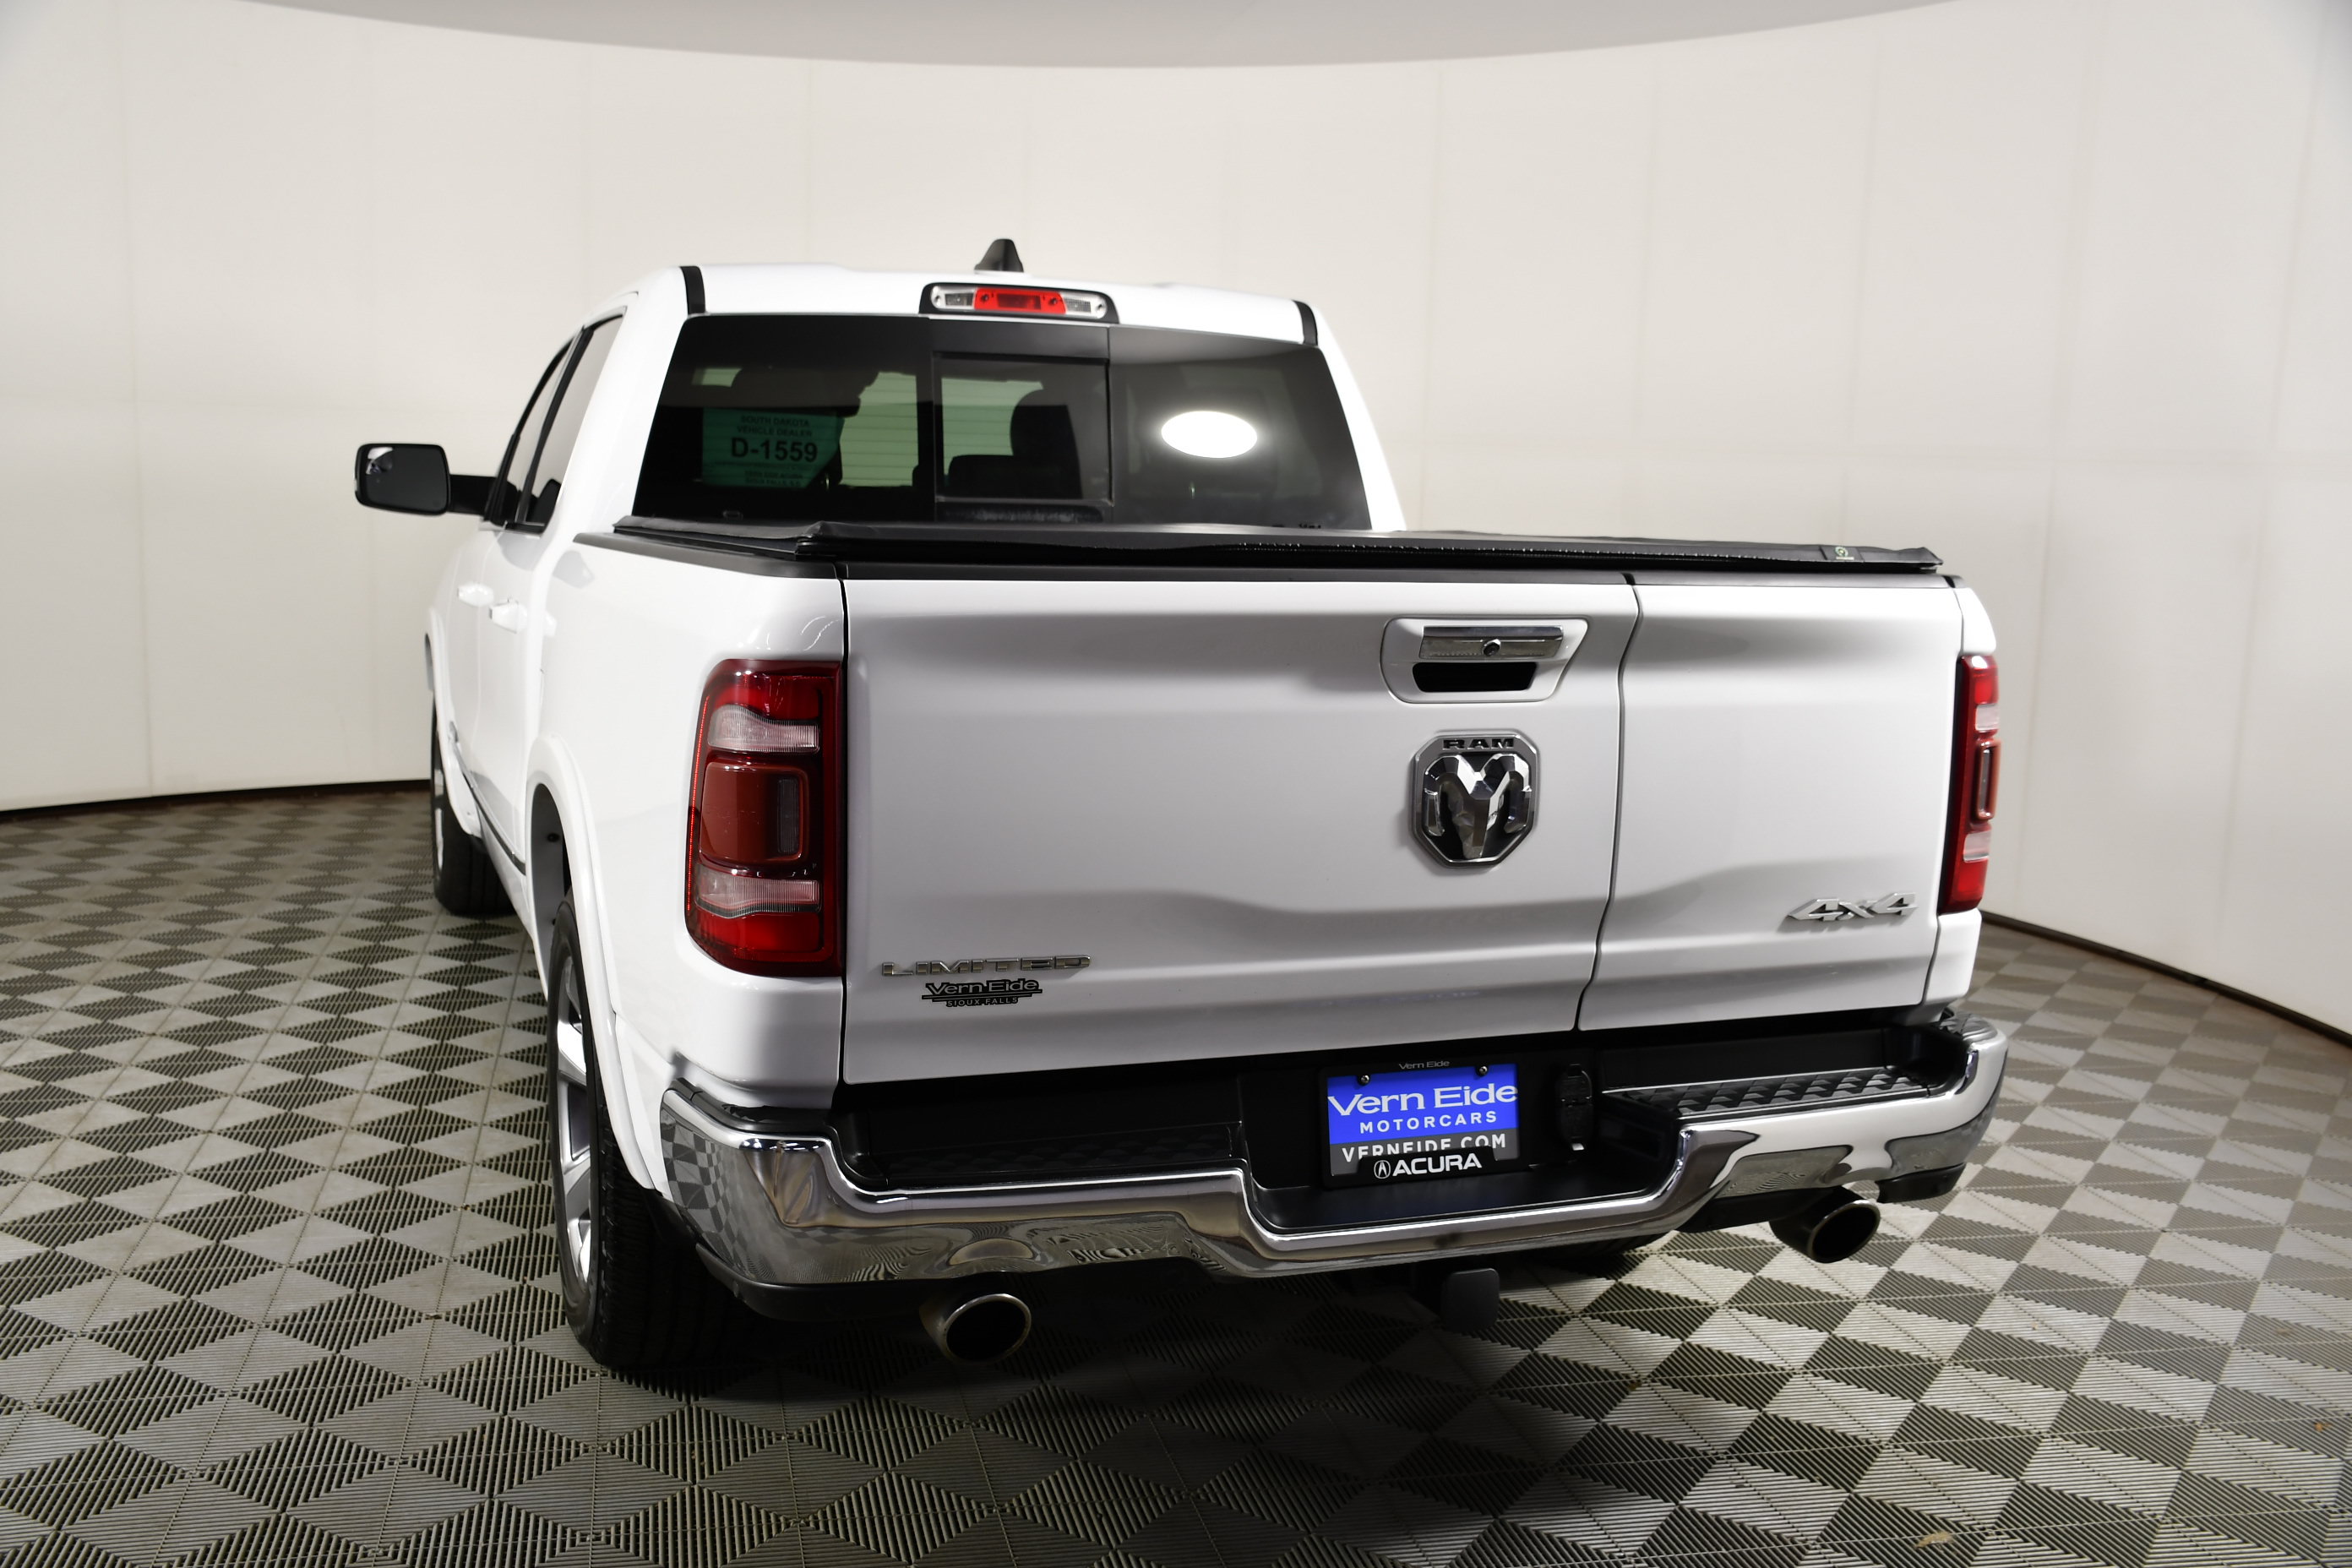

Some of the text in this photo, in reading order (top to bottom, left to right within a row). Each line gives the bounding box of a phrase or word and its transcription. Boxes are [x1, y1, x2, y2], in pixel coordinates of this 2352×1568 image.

[773, 416, 810, 427] DAKOTA
[731, 437, 818, 462] D-1559
[1442, 738, 1515, 750] RAM
[882, 955, 1091, 976] LIMITED
[928, 978, 1039, 995] Vern Eide
[947, 997, 1018, 1007] SIOUX FALLS
[1327, 1083, 1519, 1116] Vern Eide
[1359, 1110, 1498, 1134] MOTORCARS
[1392, 1152, 1483, 1177] ACURA
